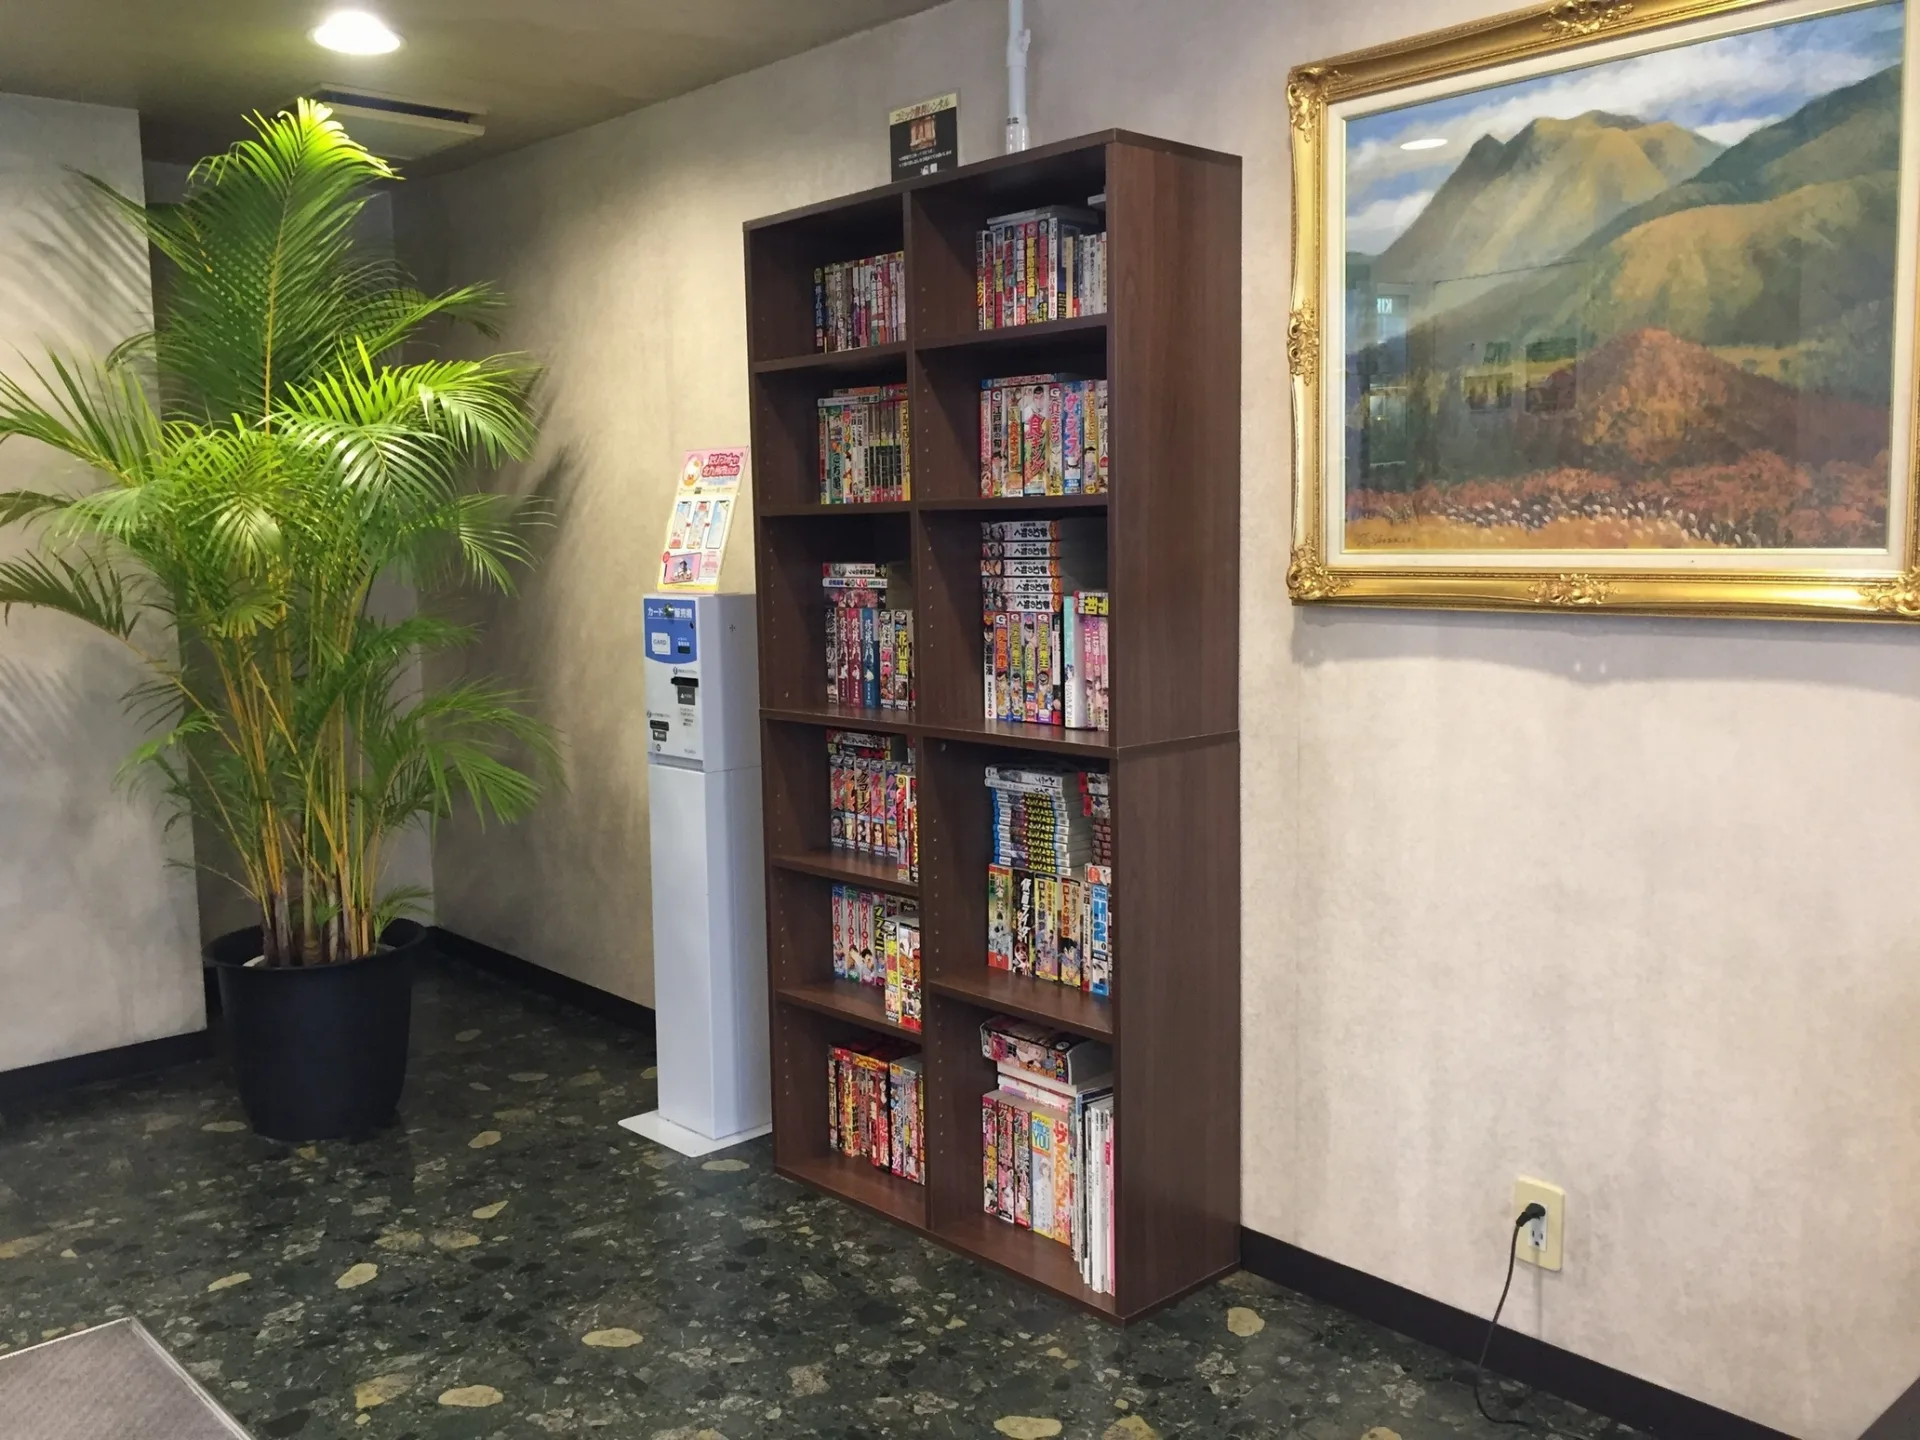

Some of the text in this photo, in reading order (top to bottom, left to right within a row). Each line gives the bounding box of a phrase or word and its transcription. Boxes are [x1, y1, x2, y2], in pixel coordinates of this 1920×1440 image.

[992, 405, 1002, 449] 江戸前の旬
[647, 607, 664, 617] カード
[858, 769, 871, 814] クローズ
[833, 896, 841, 941] MAJOR
[860, 903, 869, 948] MAJOR
[1020, 877, 1032, 944] 仮面ライダー
[1032, 1134, 1050, 1151] YOU
